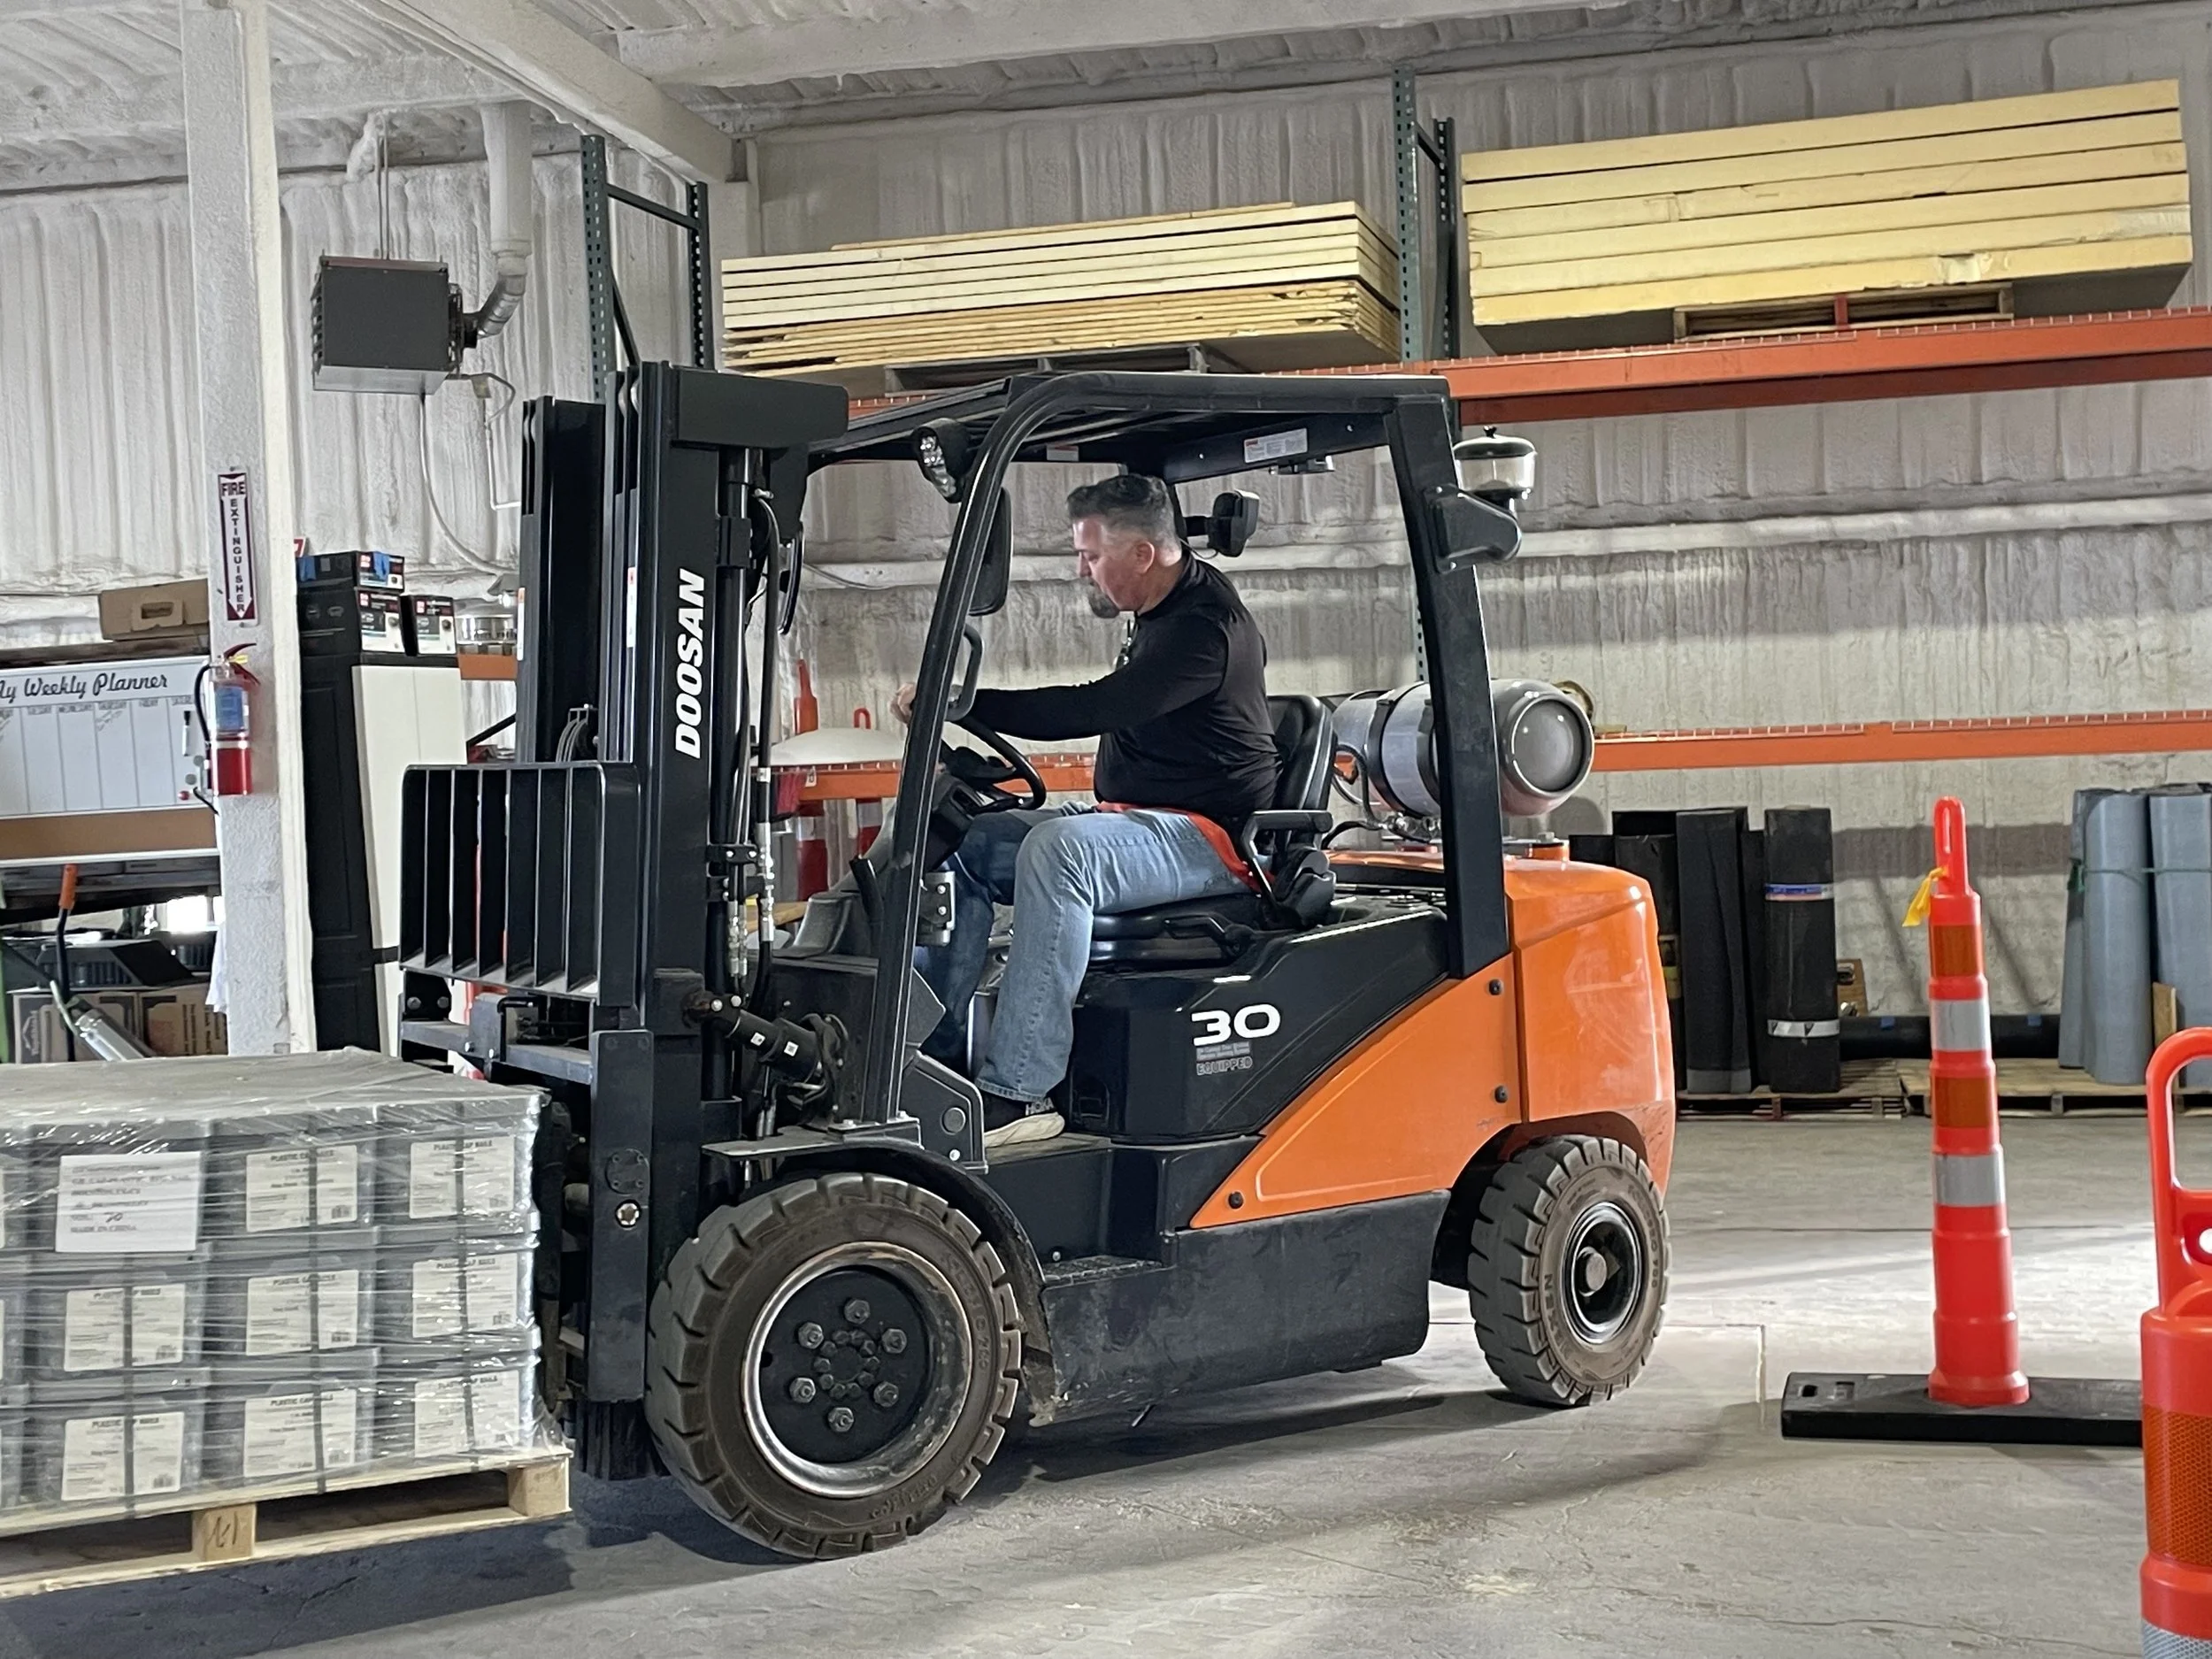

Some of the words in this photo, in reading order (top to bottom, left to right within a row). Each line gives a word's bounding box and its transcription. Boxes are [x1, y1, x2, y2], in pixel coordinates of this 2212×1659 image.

[221, 481, 246, 496] FIRE
[230, 498, 245, 612] EXTINGUISHER
[674, 568, 705, 759] DOOSAN
[24, 674, 88, 700] Weekly
[93, 672, 168, 696] Planner
[1191, 1002, 1281, 1047] 30
[1196, 1056, 1253, 1076] EQUIPPED
[1025, 1097, 1055, 1116] HOKA
